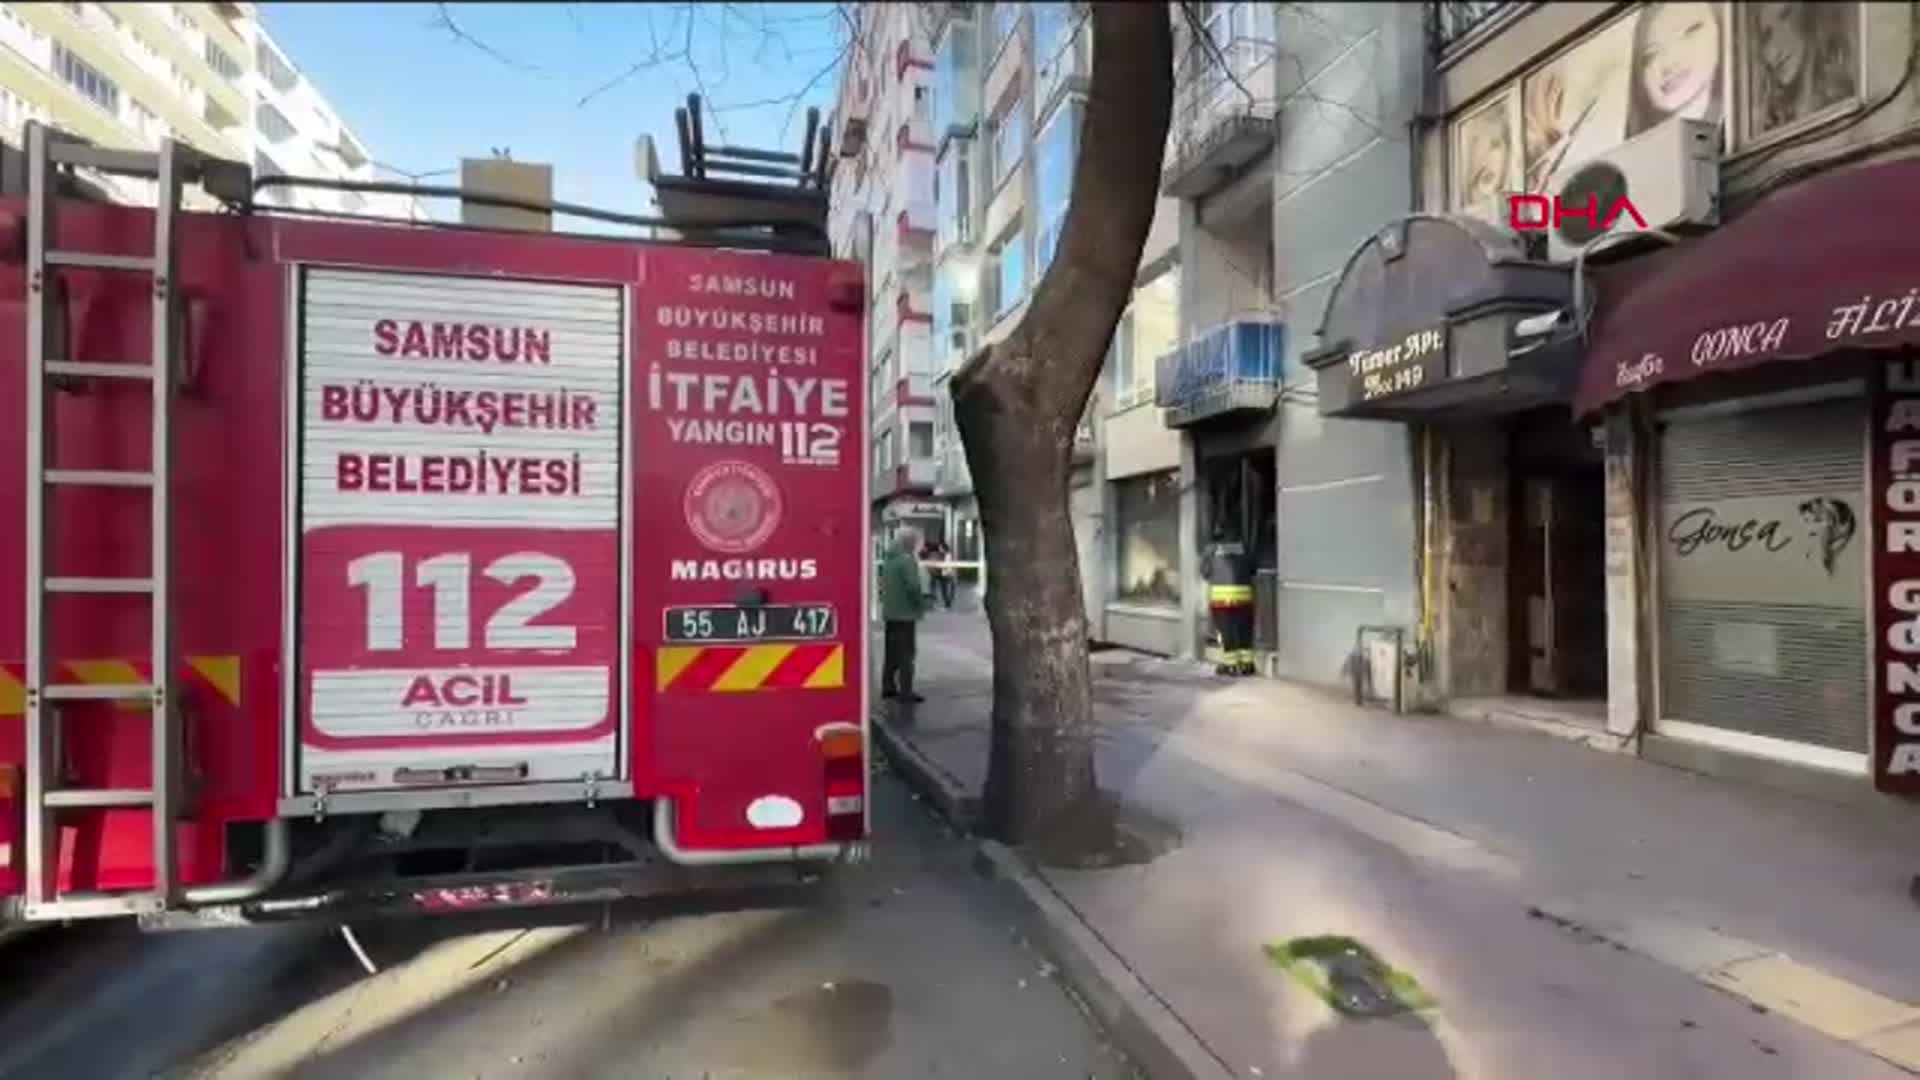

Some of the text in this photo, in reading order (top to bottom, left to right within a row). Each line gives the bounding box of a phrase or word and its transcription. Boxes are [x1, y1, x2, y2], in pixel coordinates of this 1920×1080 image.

[688, 274, 794, 299] SAMSUN
[374, 319, 551, 364] SAMSUN
[657, 304, 824, 335] BÜYÜKŞEHİR
[1691, 317, 1789, 367] GONCA
[321, 379, 599, 435] BÜYÜKŞEHİR
[649, 361, 849, 418] İTFAİYE
[667, 418, 842, 459] YANGIN 112
[337, 449, 582, 496] BELEDİYESİ
[671, 558, 818, 581] MAGIRUS
[347, 551, 578, 652] 112
[683, 608, 830, 638] 55 AJ 417
